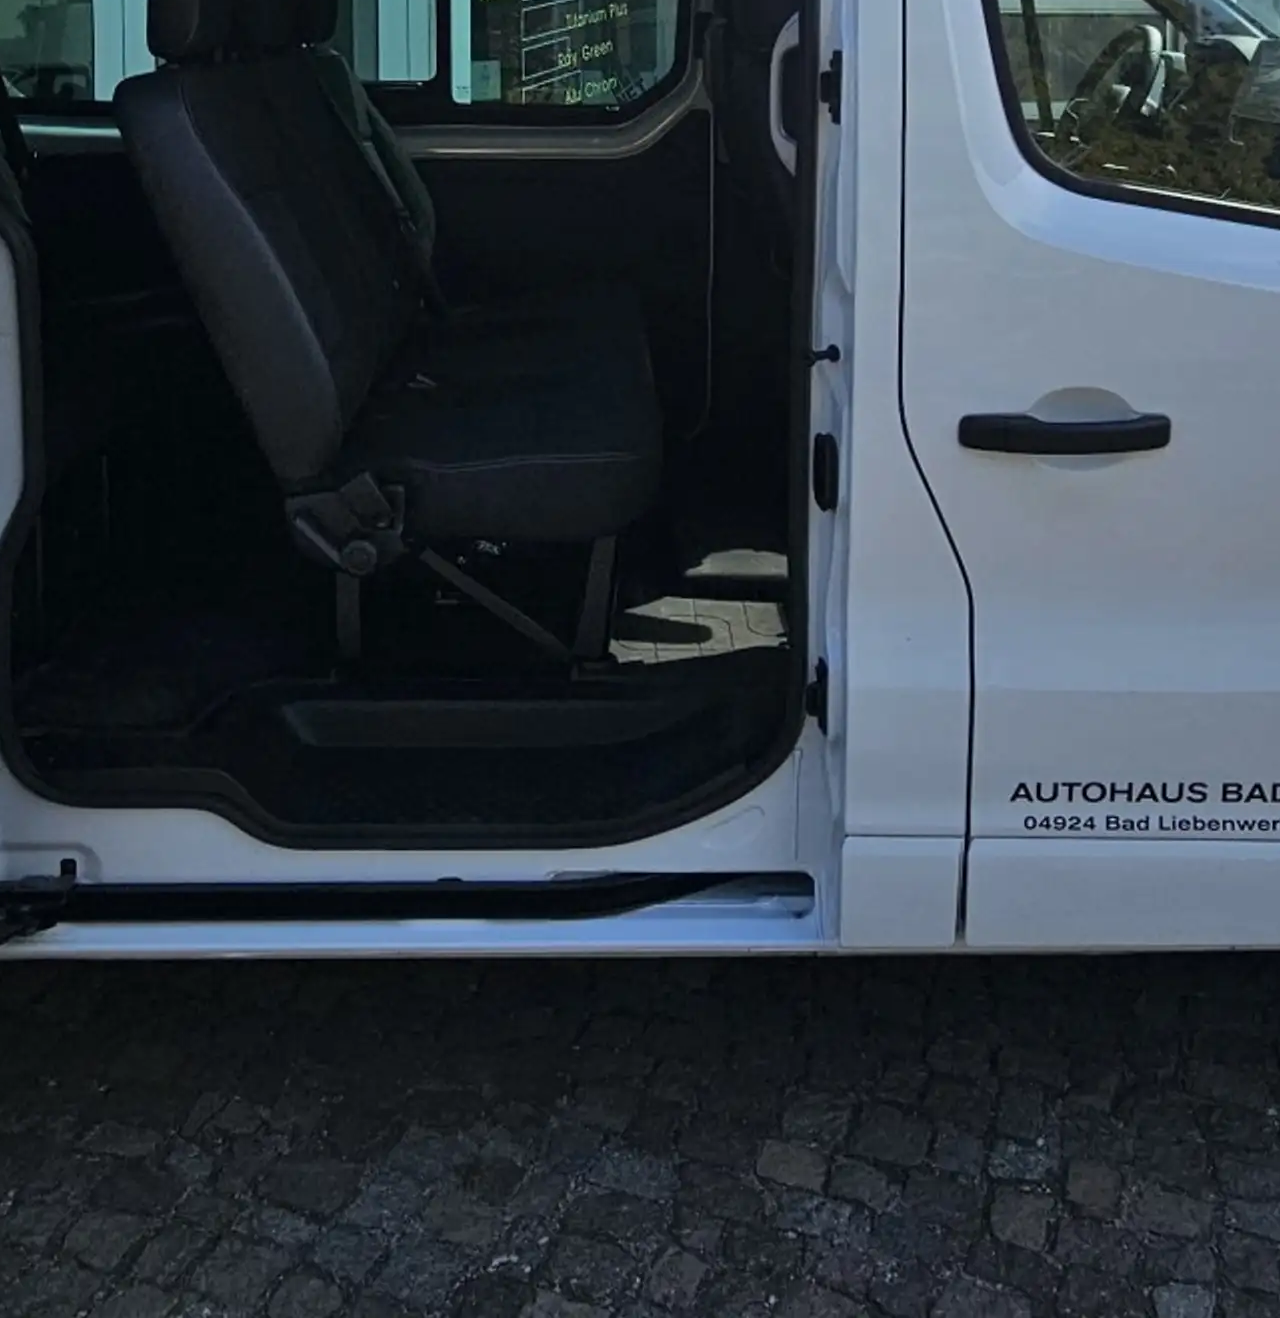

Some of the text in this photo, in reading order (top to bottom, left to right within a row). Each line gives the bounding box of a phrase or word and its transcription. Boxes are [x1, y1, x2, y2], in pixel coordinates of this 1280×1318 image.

[582, 40, 614, 61] Green
[1009, 782, 1208, 804] AUTOHAUS
[1023, 815, 1096, 831] 04924
[1105, 815, 1150, 832] Bad
